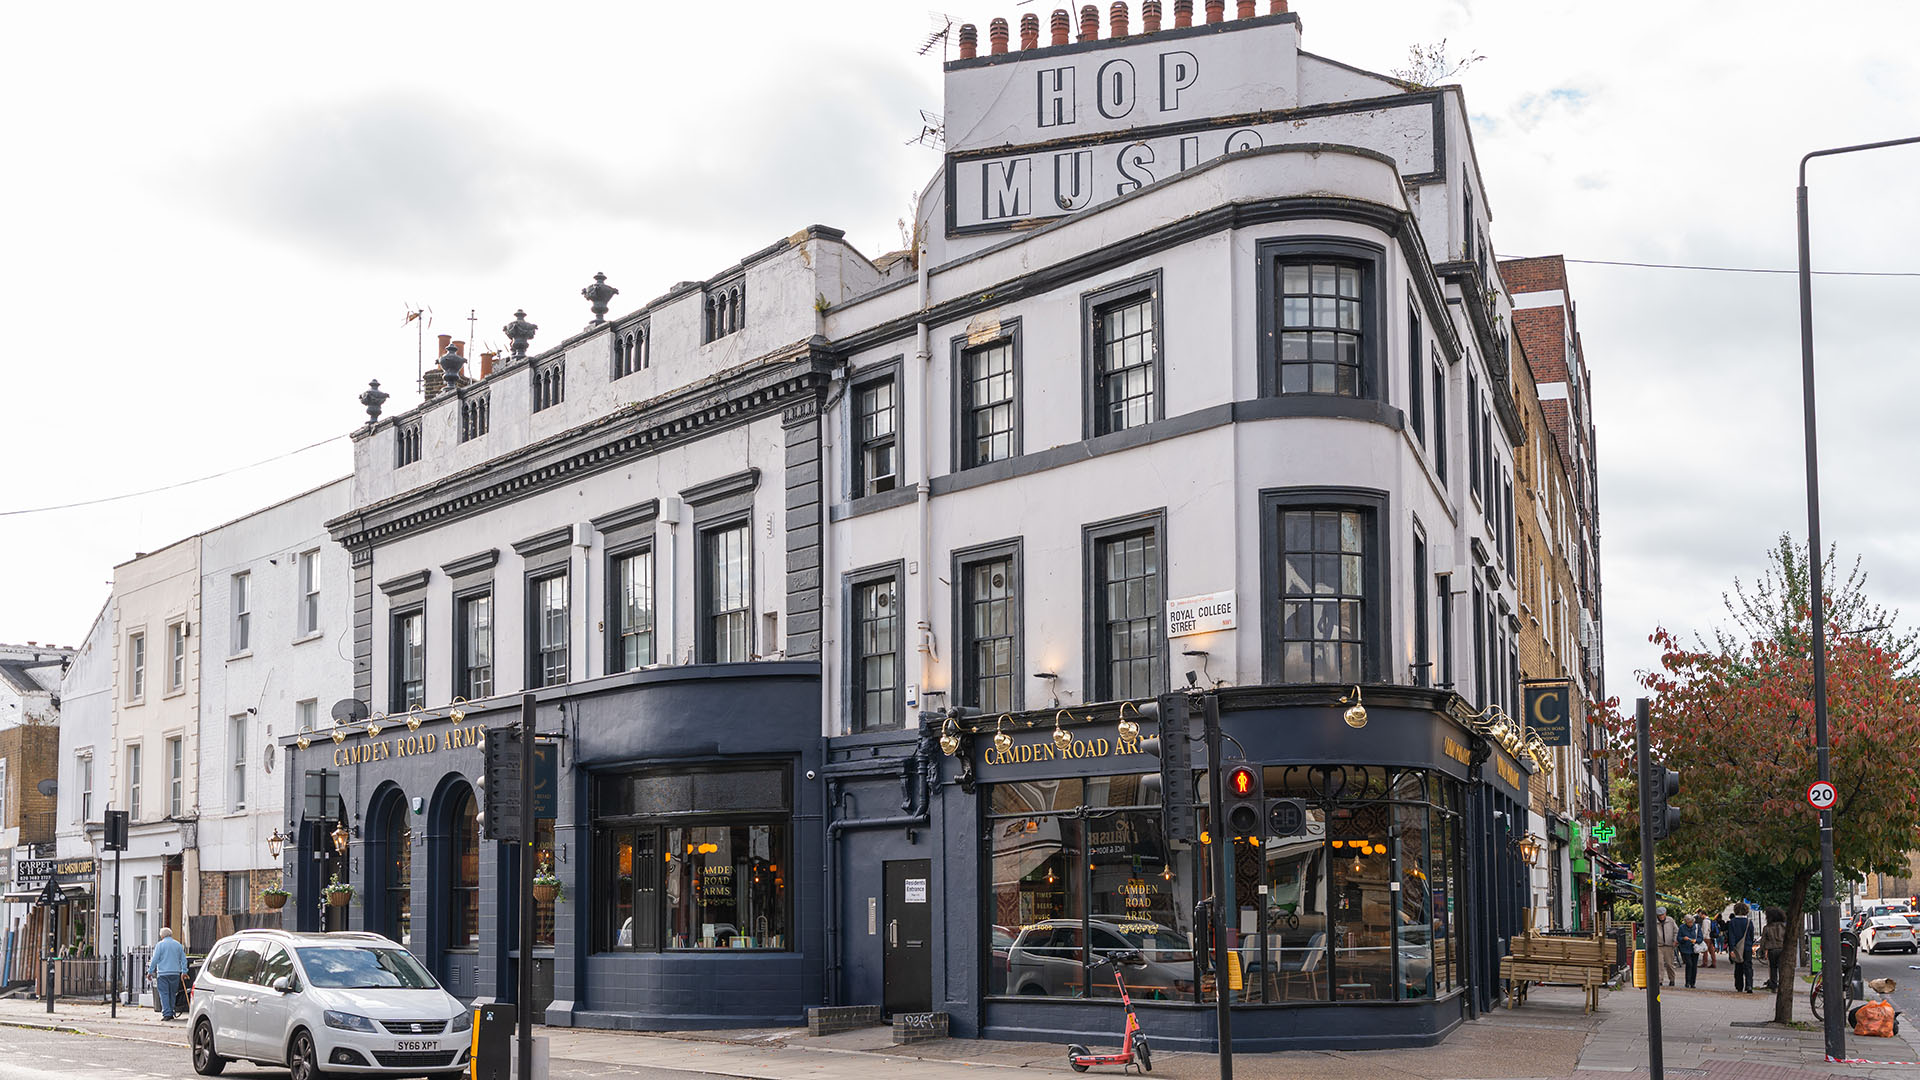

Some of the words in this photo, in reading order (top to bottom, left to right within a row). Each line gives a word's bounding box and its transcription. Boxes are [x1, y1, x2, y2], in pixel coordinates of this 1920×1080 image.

[1037, 51, 1199, 128] HOP
[1170, 609, 1195, 622] ROYAL
[1198, 602, 1232, 617] COLLEGE
[1170, 620, 1197, 633] STREET
[1534, 692, 1561, 724] C
[333, 740, 391, 767] CAMDEN
[397, 733, 436, 758] ROAD
[443, 723, 488, 750] ARMS
[984, 743, 1056, 765] CAMDEN
[1062, 738, 1109, 760] ROAD
[1812, 789, 1833, 801] 20
[79, 861, 93, 873] CARPET
[697, 866, 737, 875] CAMDEN
[704, 876, 730, 885] ROAD
[703, 887, 731, 896] ARMS
[1118, 884, 1159, 895] CAMDEN
[1125, 897, 1152, 908] ROAD
[1125, 911, 1152, 921] ARMS
[398, 1041, 420, 1050] SY66
[422, 1041, 438, 1050] XPT
